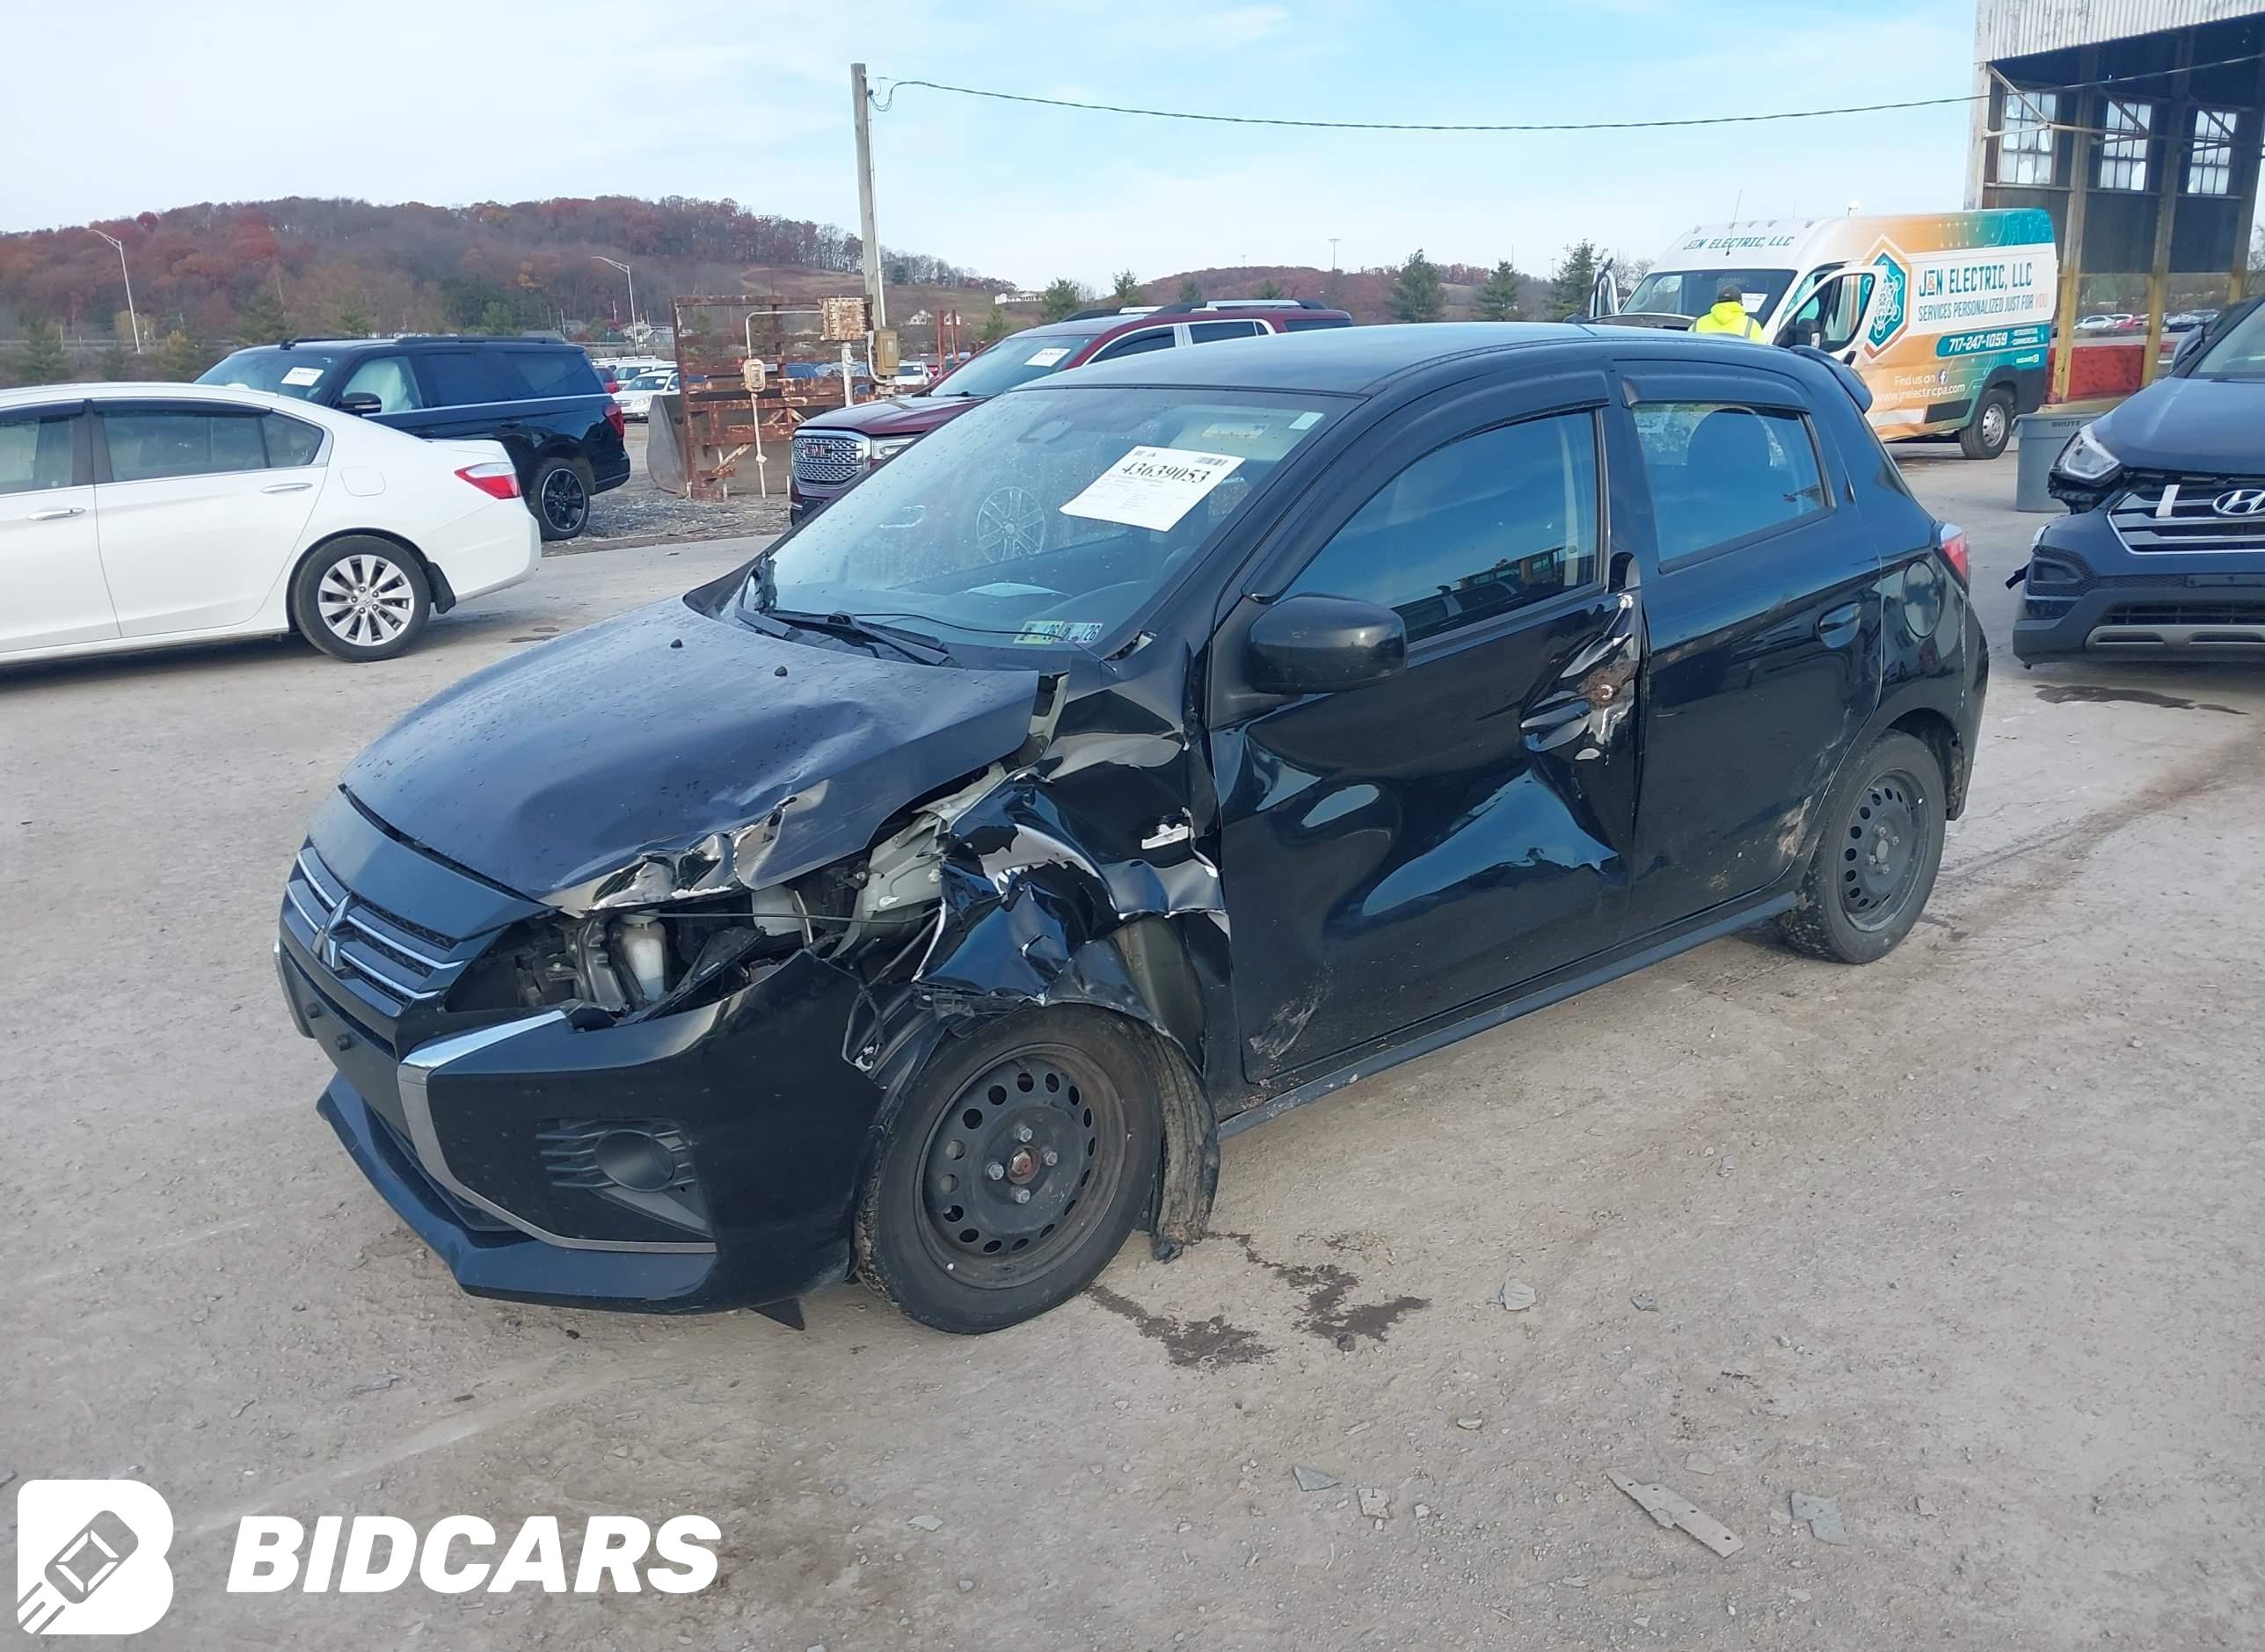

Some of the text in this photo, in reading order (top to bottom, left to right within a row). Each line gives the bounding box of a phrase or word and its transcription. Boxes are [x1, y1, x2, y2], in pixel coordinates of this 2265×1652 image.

[1768, 236, 1795, 246] LLC
[1948, 264, 2008, 294] ELECTRIC,
[2012, 262, 2033, 287] LLC
[1918, 293, 2049, 322] SERVICES PERSONALIZED JUST FOR YOU
[1948, 332, 2008, 353] 717-247-1059
[1894, 374, 1912, 386] Find
[1912, 374, 1923, 384] us
[1924, 374, 1936, 384] on
[804, 443, 832, 458] GMC
[1122, 462, 1211, 483] 43639053
